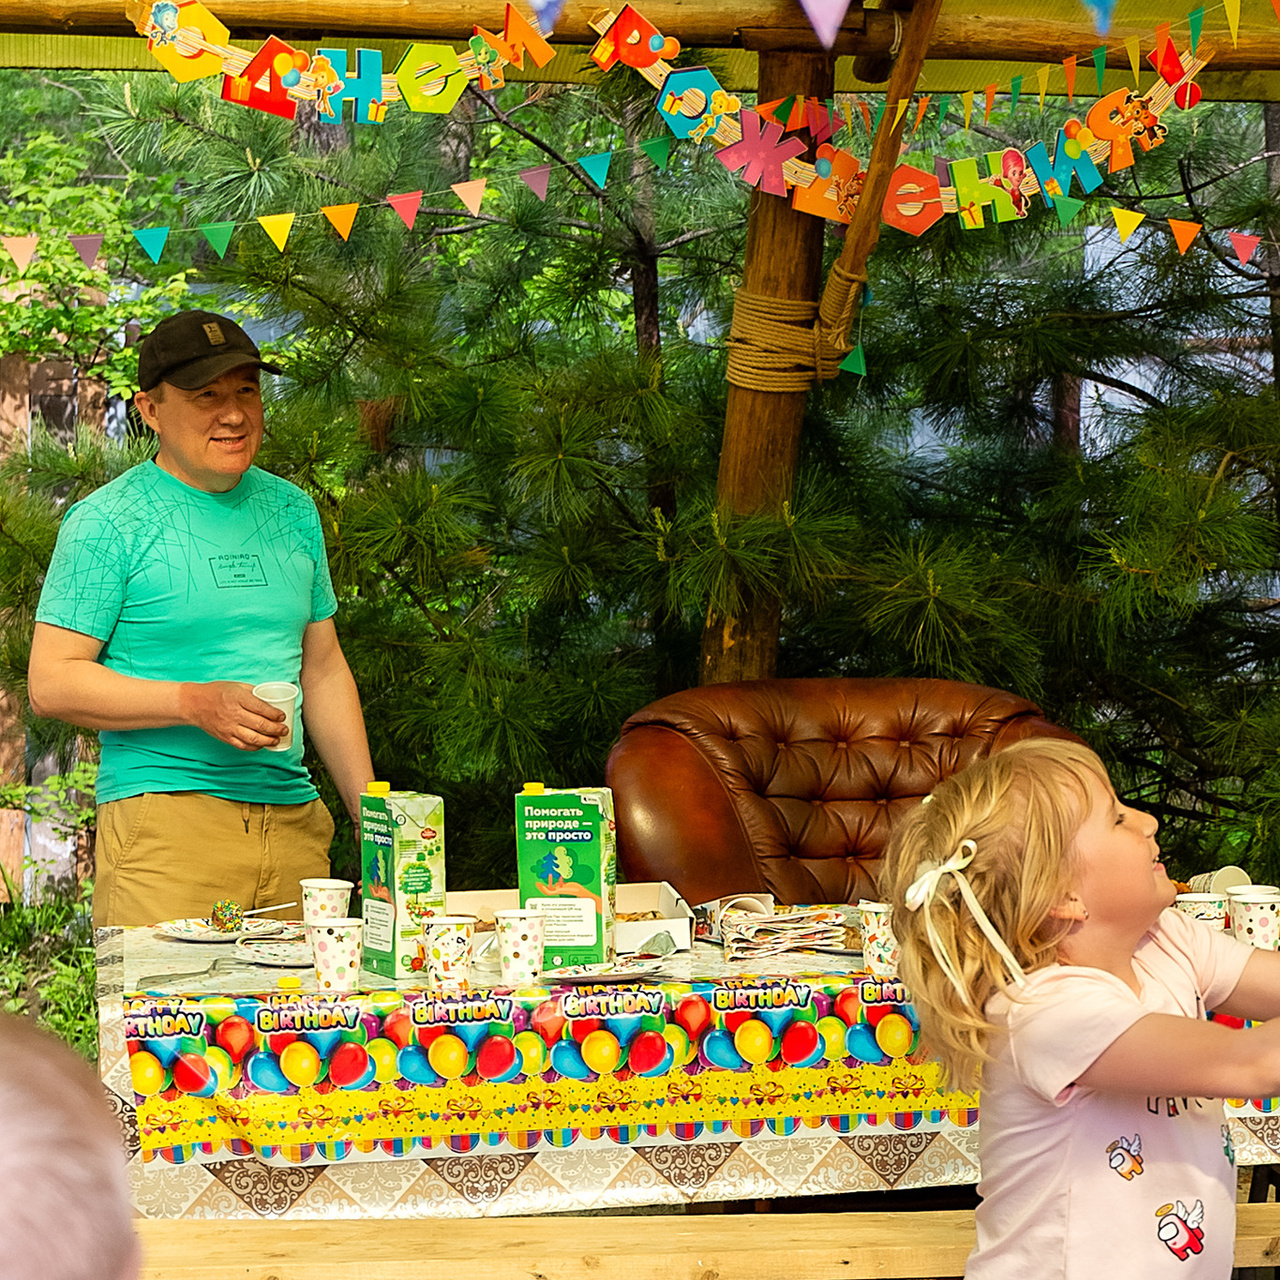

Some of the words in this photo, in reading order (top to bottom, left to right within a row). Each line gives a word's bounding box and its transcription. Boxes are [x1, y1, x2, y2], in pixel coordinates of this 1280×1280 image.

[524, 806, 584, 817] Помогать
[525, 820, 580, 831] природе
[363, 832, 374, 842] это
[525, 831, 547, 841] это
[547, 831, 592, 843] просто
[564, 991, 663, 1017] BIRTHDAY
[714, 985, 811, 1010] BIRTHDAY
[257, 1005, 359, 1032] BIRTHDAY
[413, 998, 512, 1025] BIRTHDAY
